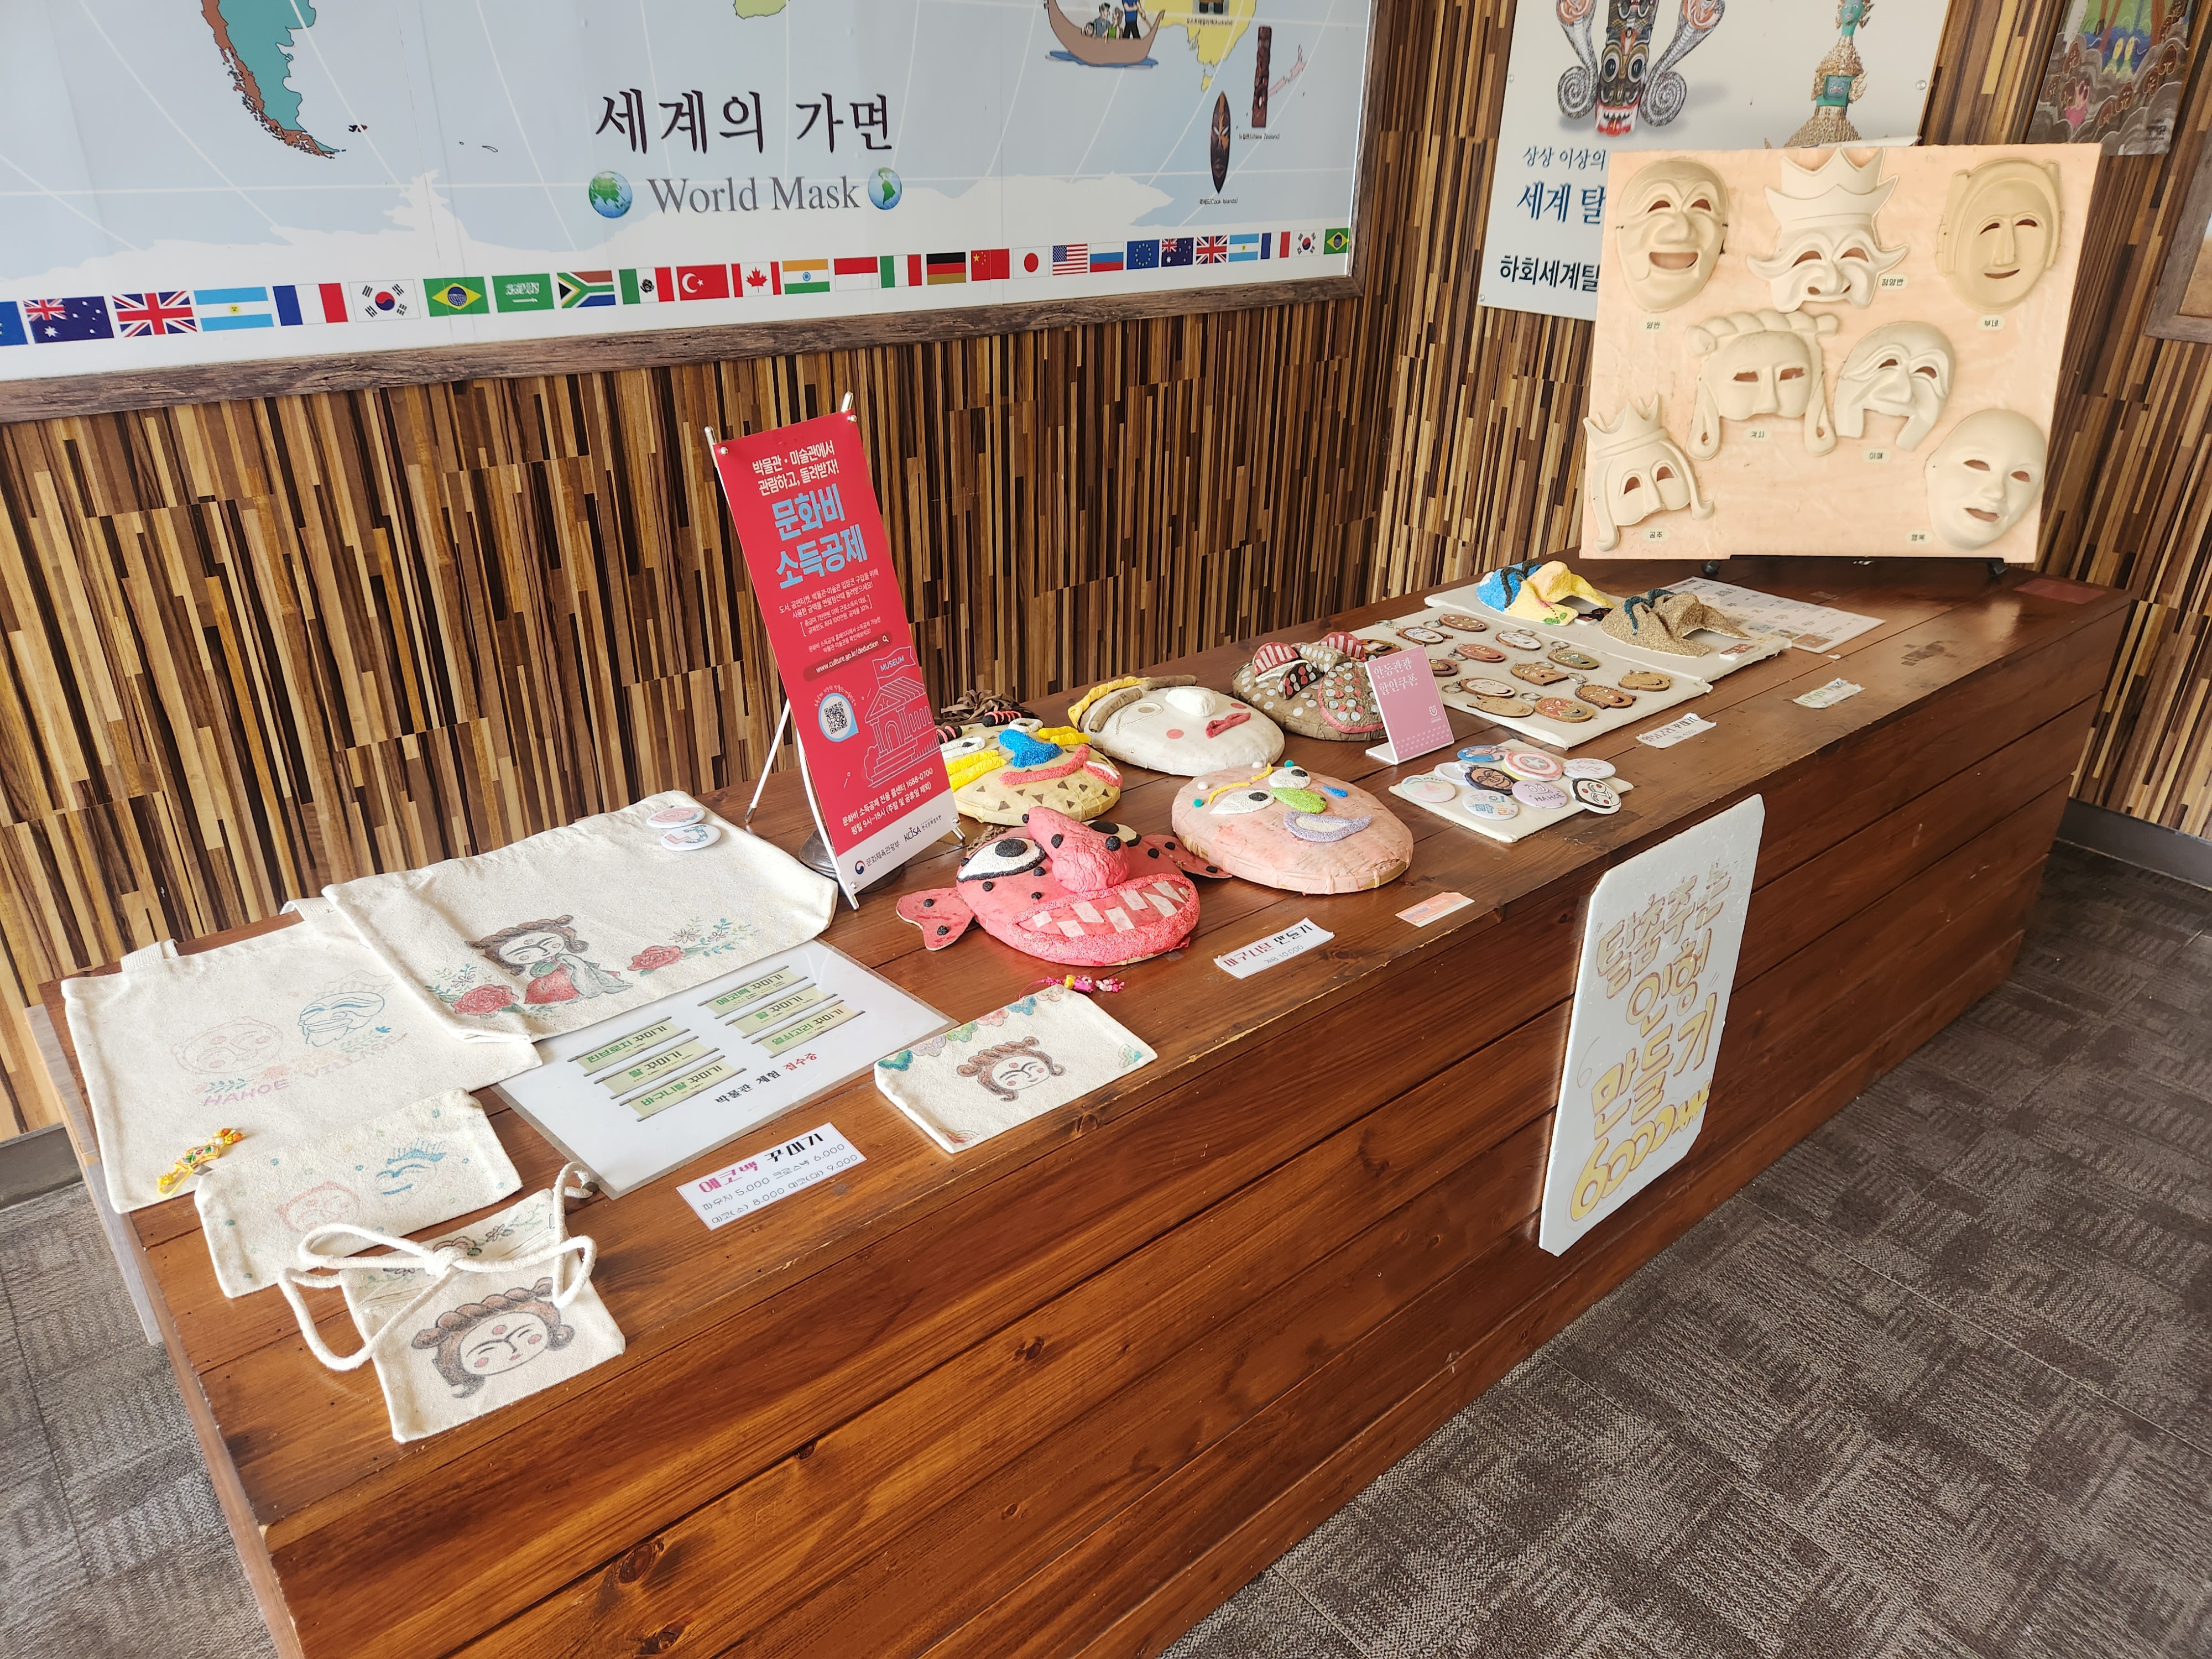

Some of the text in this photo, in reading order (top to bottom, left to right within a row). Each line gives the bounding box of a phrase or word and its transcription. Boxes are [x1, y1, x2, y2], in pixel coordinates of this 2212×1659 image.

[596, 88, 893, 154] 세계의 가면
[1522, 145, 1606, 172] 상상 이상의
[646, 175, 861, 215] World Mask
[1516, 180, 1606, 226] 세계 탈
[752, 455, 782, 476] 박물관
[789, 440, 835, 465] 미술관에서
[758, 458, 839, 496] 관람하고, 돌려받자!
[771, 483, 846, 541] 문화비
[776, 524, 868, 589] 소득공제
[855, 573, 869, 584] 구입을
[869, 568, 879, 578] 위해
[792, 607, 807, 619] 사용한
[846, 581, 873, 598] 돌려받으세요!
[816, 640, 879, 674] www.culture.go.kr/deduction
[880, 655, 905, 672] MUSEUM
[1374, 657, 1412, 680] 안동관광
[1379, 673, 1418, 695] 할인쿠폰
[842, 767, 933, 827] 문화비 소득공제 전용 콜센터 1688-0700
[851, 781, 932, 835] 평일 9시~18시 (주말 및 공휴일 제외)
[1535, 792, 1565, 802] HAHOE
[866, 840, 900, 867] 문화체육관광부
[1223, 924, 1313, 967] 바구니탈 만들기
[1597, 862, 1731, 1000] 탈춤추는
[716, 988, 751, 1005] 에코백
[750, 974, 784, 990] 꾸미기
[1626, 928, 1712, 1038] 인형
[769, 996, 804, 1013] 꾸미기
[632, 1026, 667, 1042] 꾸미기
[771, 1023, 813, 1045] 열쇠고리
[812, 1009, 844, 1025] 꾸미기
[644, 1051, 682, 1070] 꾸미기
[714, 1084, 753, 1103] 박물관
[755, 1070, 781, 1084] 체험
[783, 1053, 817, 1071] 접수중
[1592, 992, 1718, 1140] 만들기
[204, 1079, 289, 1107] HAHOE
[640, 1082, 688, 1106] 바구니탈
[687, 1065, 723, 1083] 꾸미기
[698, 1133, 824, 1193] 에코백 꾸미기
[702, 1193, 733, 1211] 파우치
[735, 1177, 770, 1196] 5.000
[813, 1144, 845, 1162] 6.000
[753, 1187, 785, 1206] 8.000
[827, 1154, 858, 1171] 9.000
